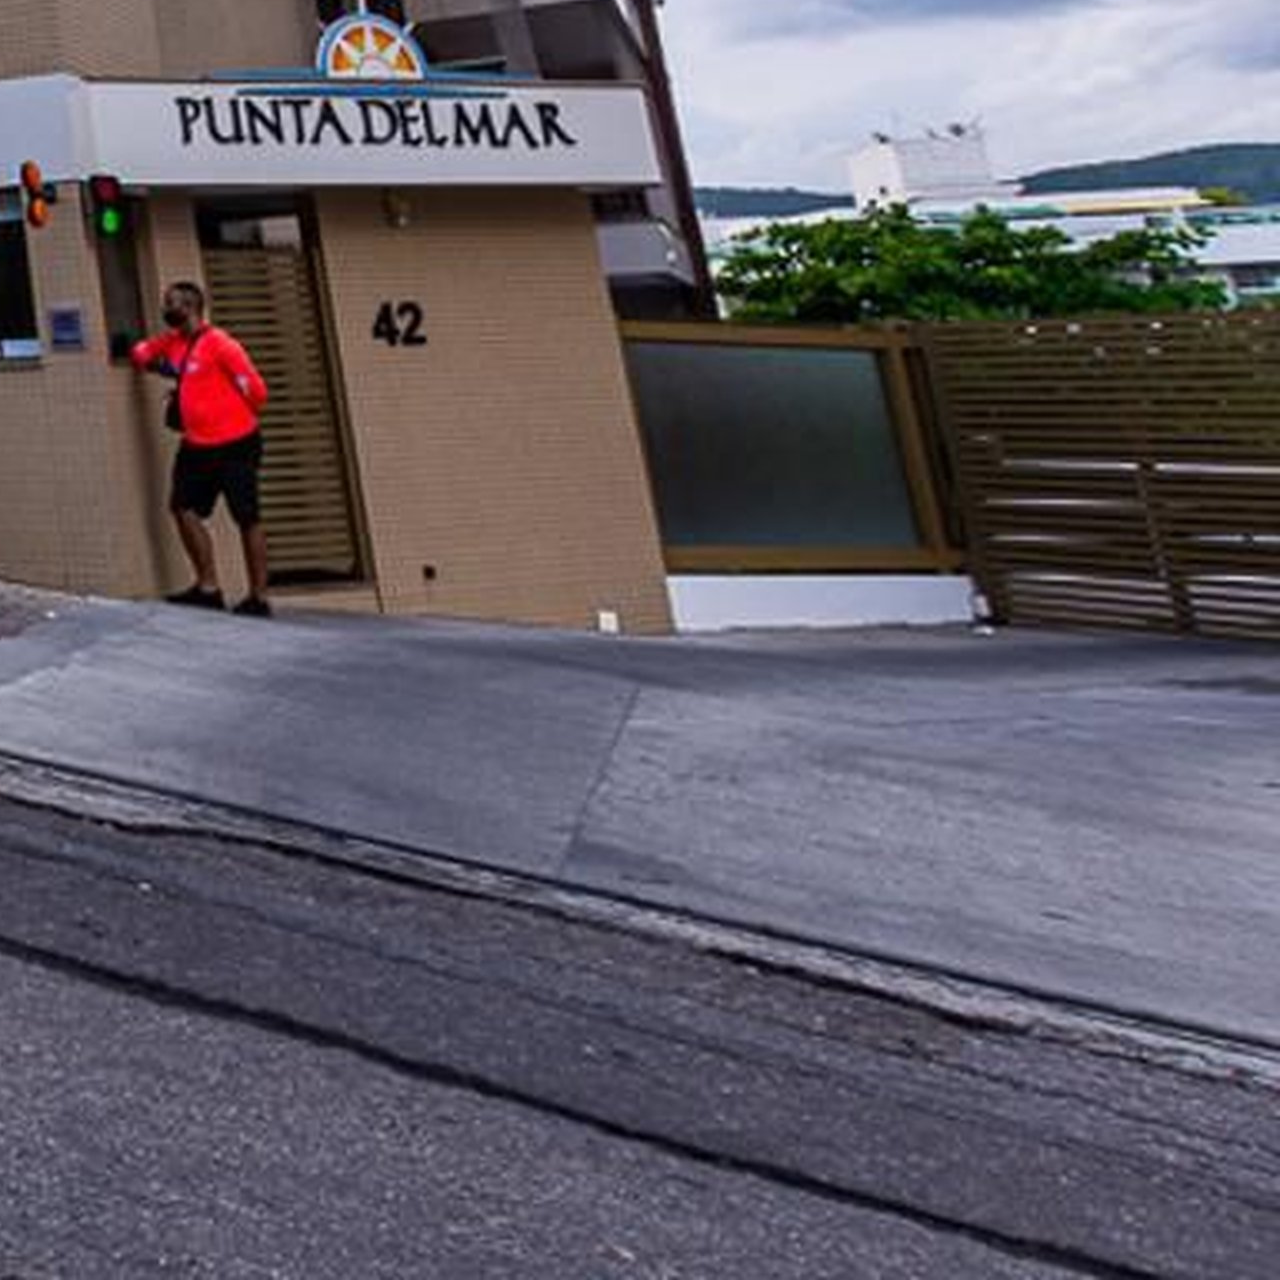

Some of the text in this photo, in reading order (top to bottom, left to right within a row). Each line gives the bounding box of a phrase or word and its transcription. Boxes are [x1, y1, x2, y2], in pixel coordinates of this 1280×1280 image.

[175, 97, 577, 149] PUNTA DEL MAR
[373, 301, 427, 347] 42
